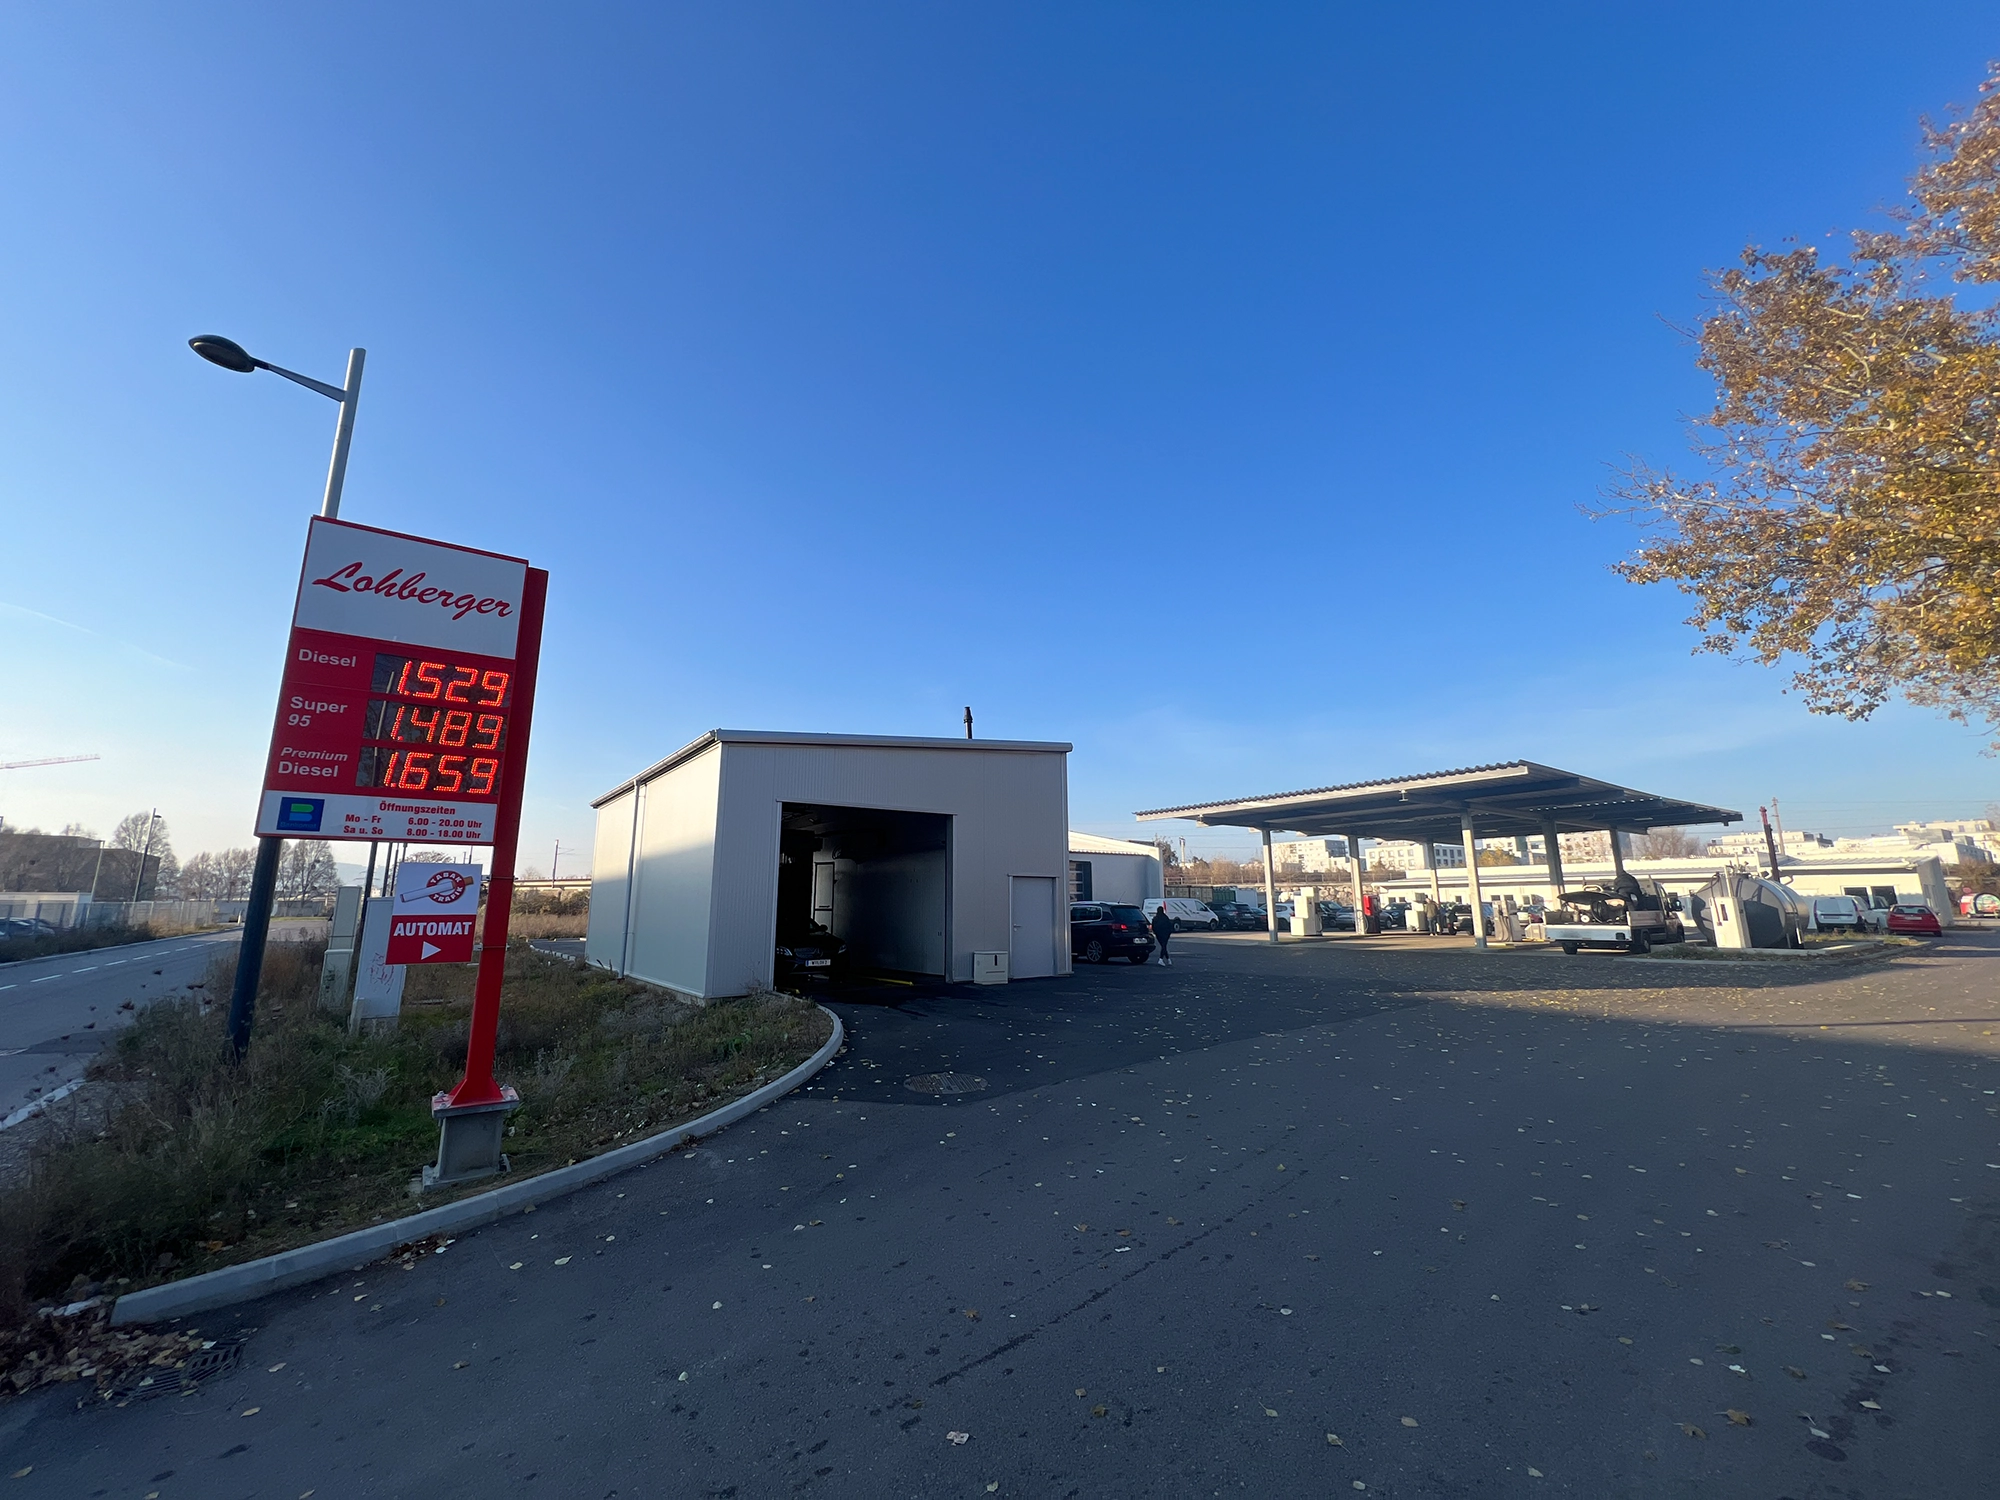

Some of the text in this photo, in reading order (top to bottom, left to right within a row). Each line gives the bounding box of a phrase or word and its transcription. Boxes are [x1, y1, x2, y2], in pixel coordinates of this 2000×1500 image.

[311, 561, 513, 621] Lohberger
[298, 648, 357, 668] Diesel
[397, 660, 509, 707] 1.529
[290, 696, 348, 714] Super
[287, 714, 312, 727] 95
[390, 705, 504, 750] 1.489
[280, 746, 349, 762] Premium
[278, 761, 339, 778] Diesel
[383, 751, 499, 795] 1.659
[379, 800, 456, 815] Öffnungszeiten
[345, 814, 362, 823] Mo
[371, 815, 382, 824] Fr
[408, 817, 429, 826] 6.00
[438, 818, 465, 828] 20.00
[467, 820, 483, 829] Uhr
[343, 825, 356, 834] Sa
[371, 826, 384, 835] So
[406, 828, 428, 837] 8.00
[437, 829, 464, 838] 18.00
[465, 830, 482, 840] Uhr
[430, 872, 463, 883] TABAK
[432, 886, 464, 902] TRAFIK
[393, 921, 473, 937] AUTOMAT
